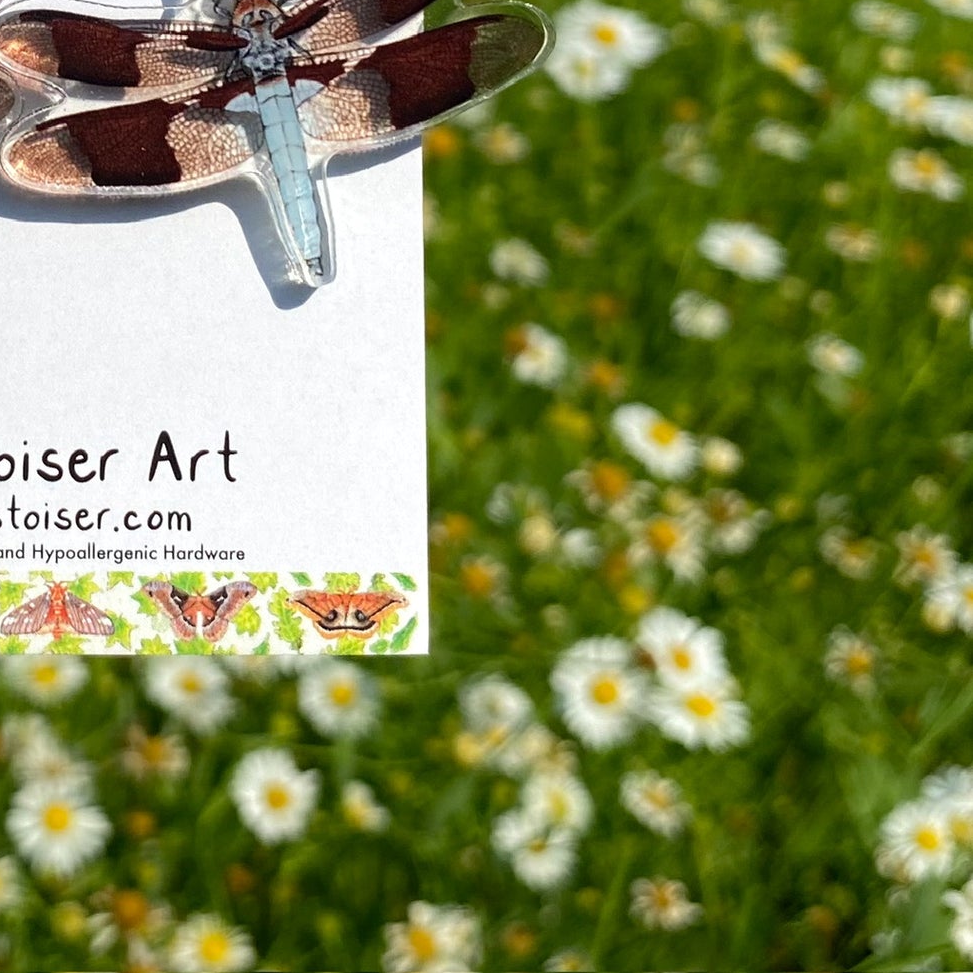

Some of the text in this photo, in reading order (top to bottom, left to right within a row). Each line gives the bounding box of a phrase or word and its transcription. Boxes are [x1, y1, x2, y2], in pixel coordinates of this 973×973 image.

[149, 431, 237, 483] Art
[32, 542, 157, 564] Hypoallergenic
[165, 544, 245, 560] Hardware
